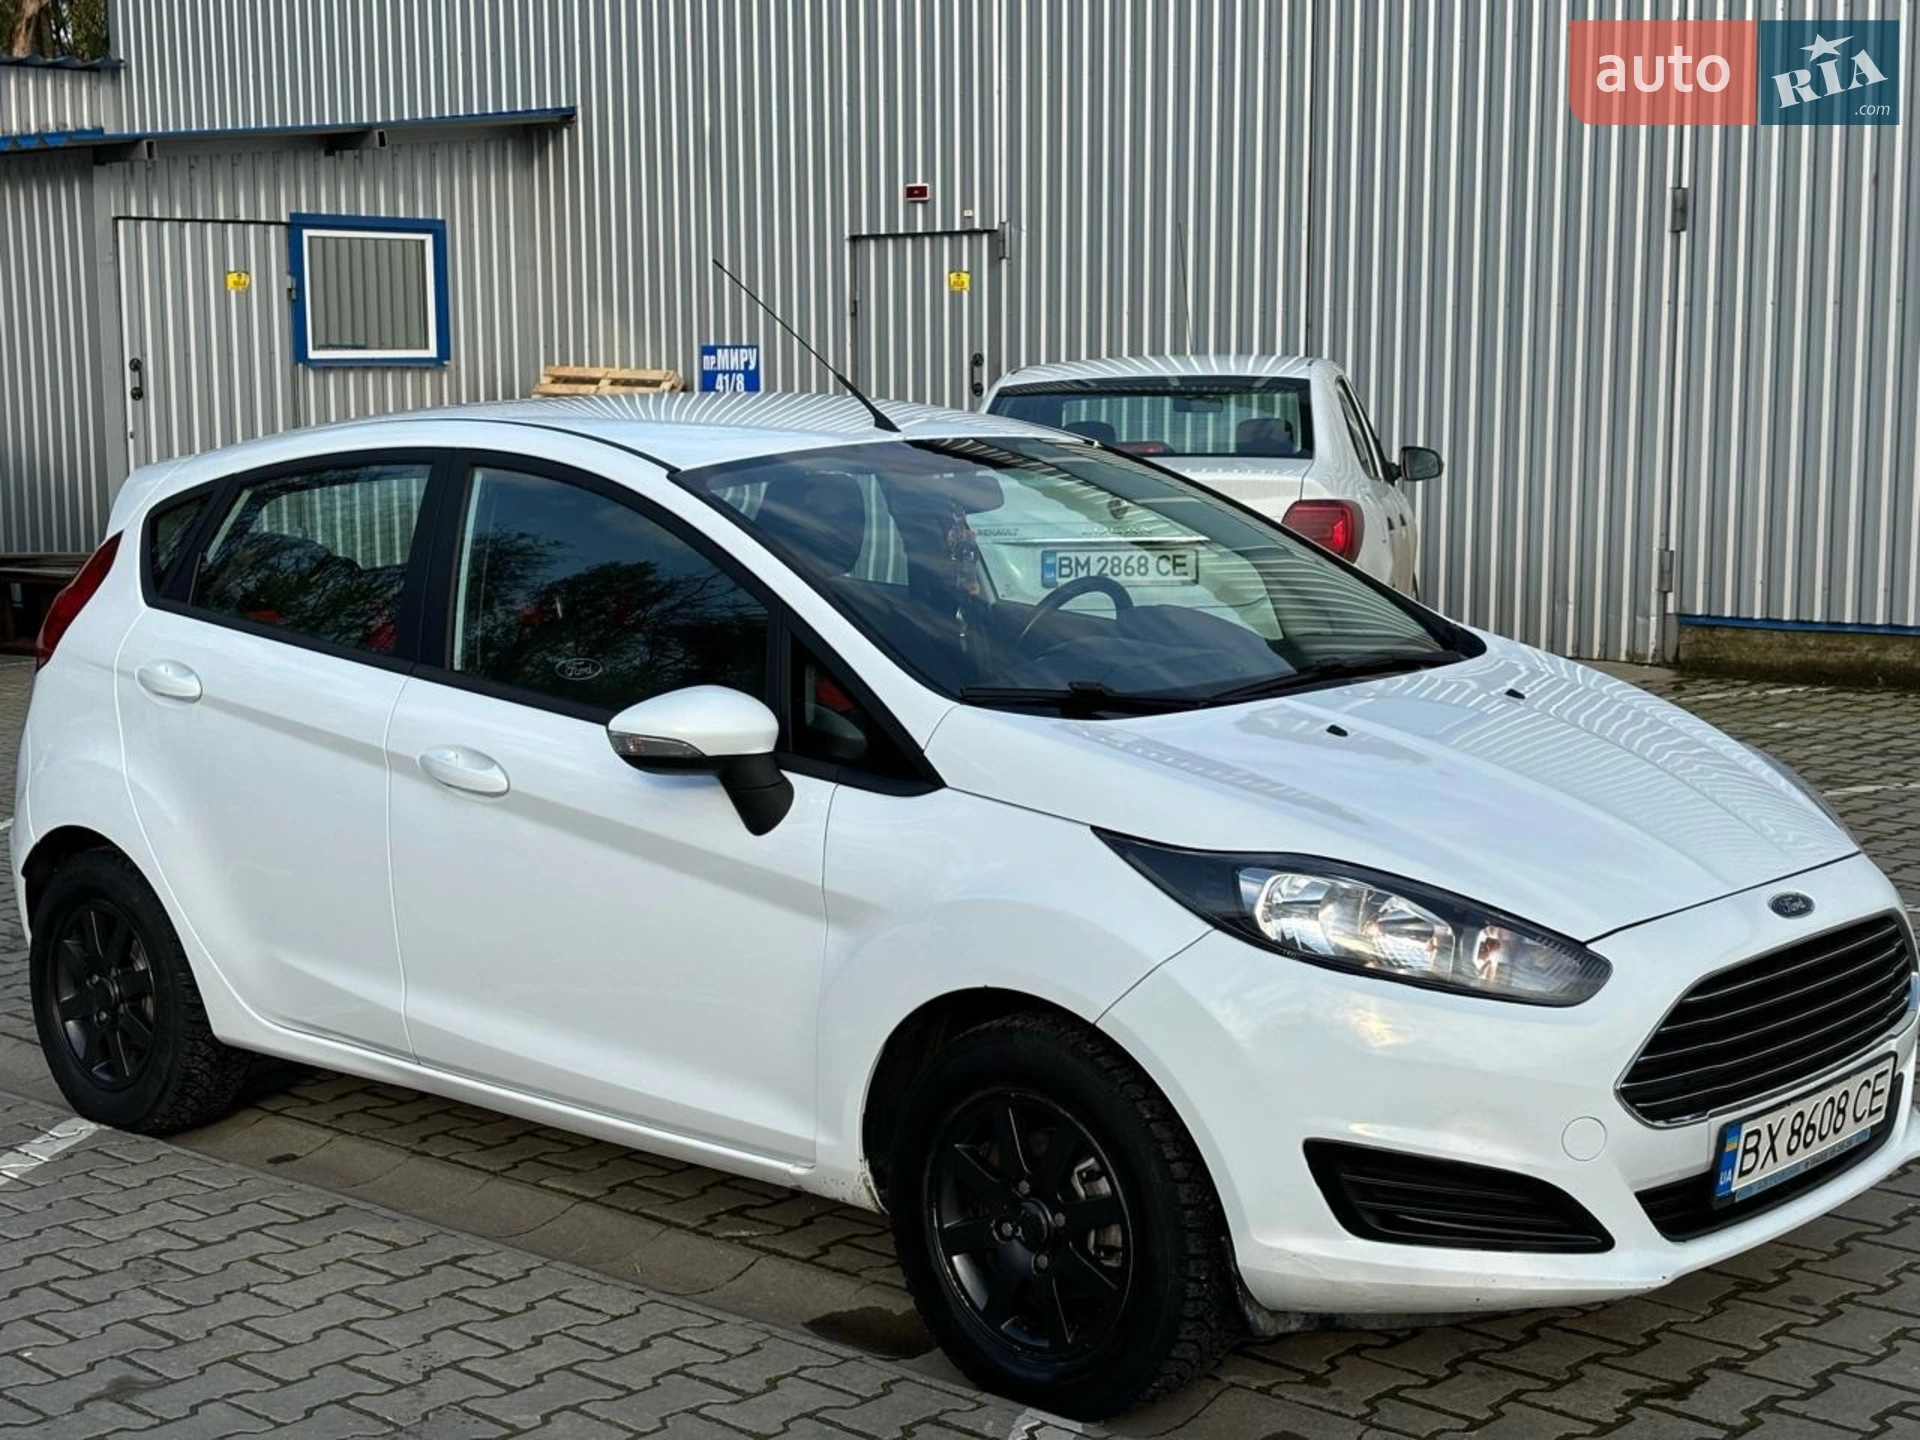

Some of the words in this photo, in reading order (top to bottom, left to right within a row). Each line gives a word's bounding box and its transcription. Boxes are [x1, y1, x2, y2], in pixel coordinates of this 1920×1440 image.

[715, 373, 745, 392] 41/8
[1058, 555, 1091, 578] BM
[1097, 554, 1149, 577] 2868
[1156, 554, 1188, 577] CE
[1737, 1117, 1786, 1178] BX
[1786, 1089, 1850, 1156] 8608
[1852, 1068, 1889, 1123] CE
[1719, 1168, 1732, 1186] UA
